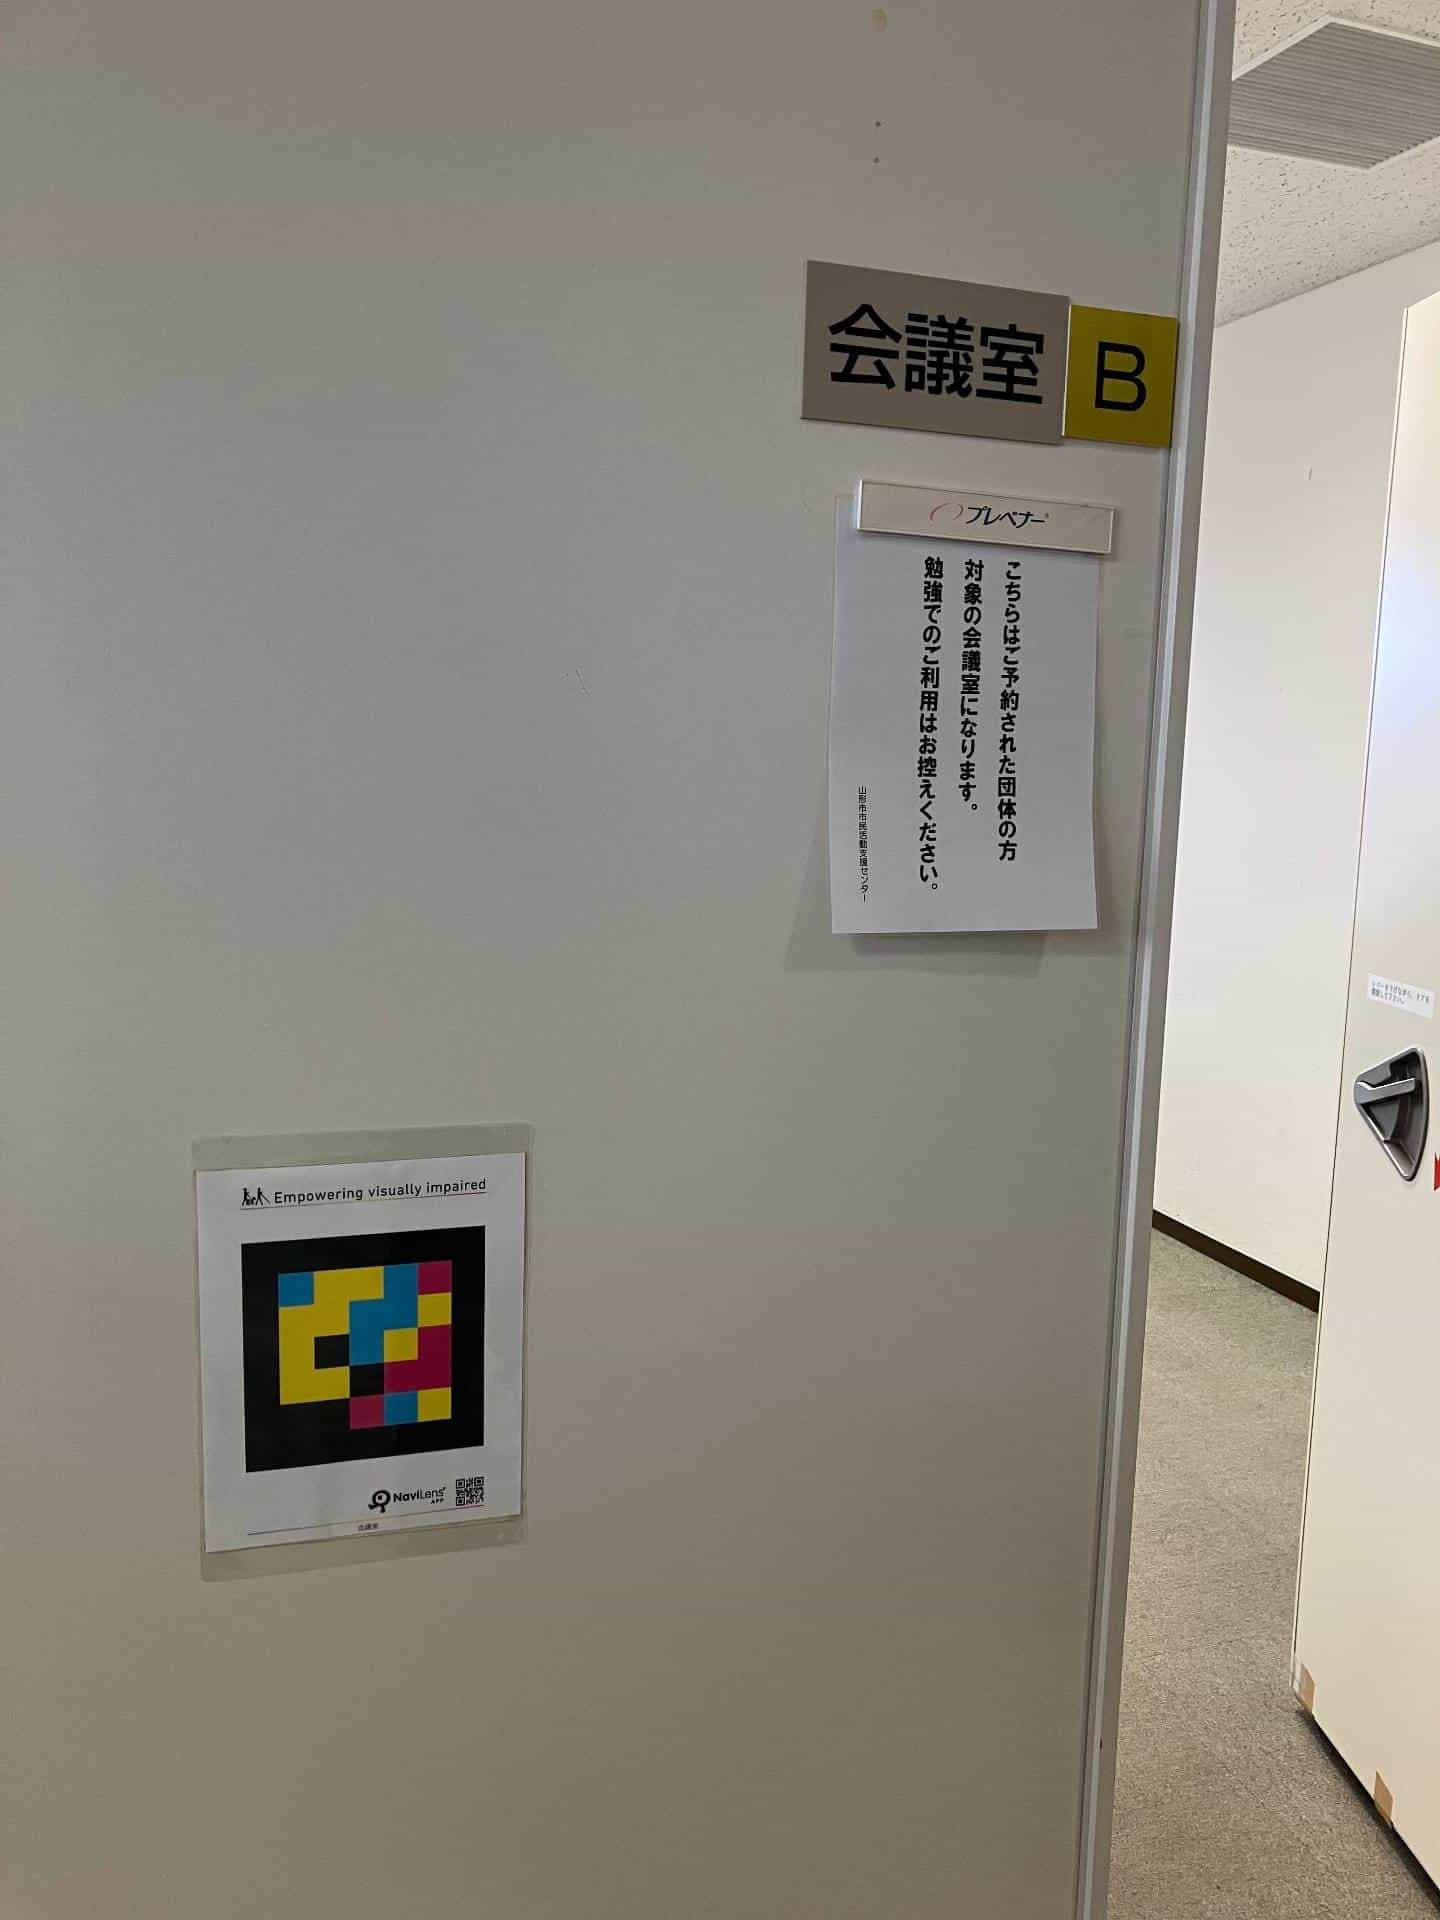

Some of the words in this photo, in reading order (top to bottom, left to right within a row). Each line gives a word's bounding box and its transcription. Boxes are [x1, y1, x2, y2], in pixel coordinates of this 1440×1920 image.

[823, 303, 1046, 406] 会議室
[1094, 340, 1148, 412] B
[965, 505, 1046, 529] プレベナー
[917, 556, 944, 890] 勉強でのご利用はお控えください。
[958, 558, 985, 811] 対象の会議室になります。
[997, 560, 1022, 861] こちらはご予約された団体の方
[274, 1187, 363, 1205] Empowering
[368, 1182, 422, 1197] visually
[426, 1178, 487, 1194] impaired
[393, 1488, 444, 1503] NaviLens
